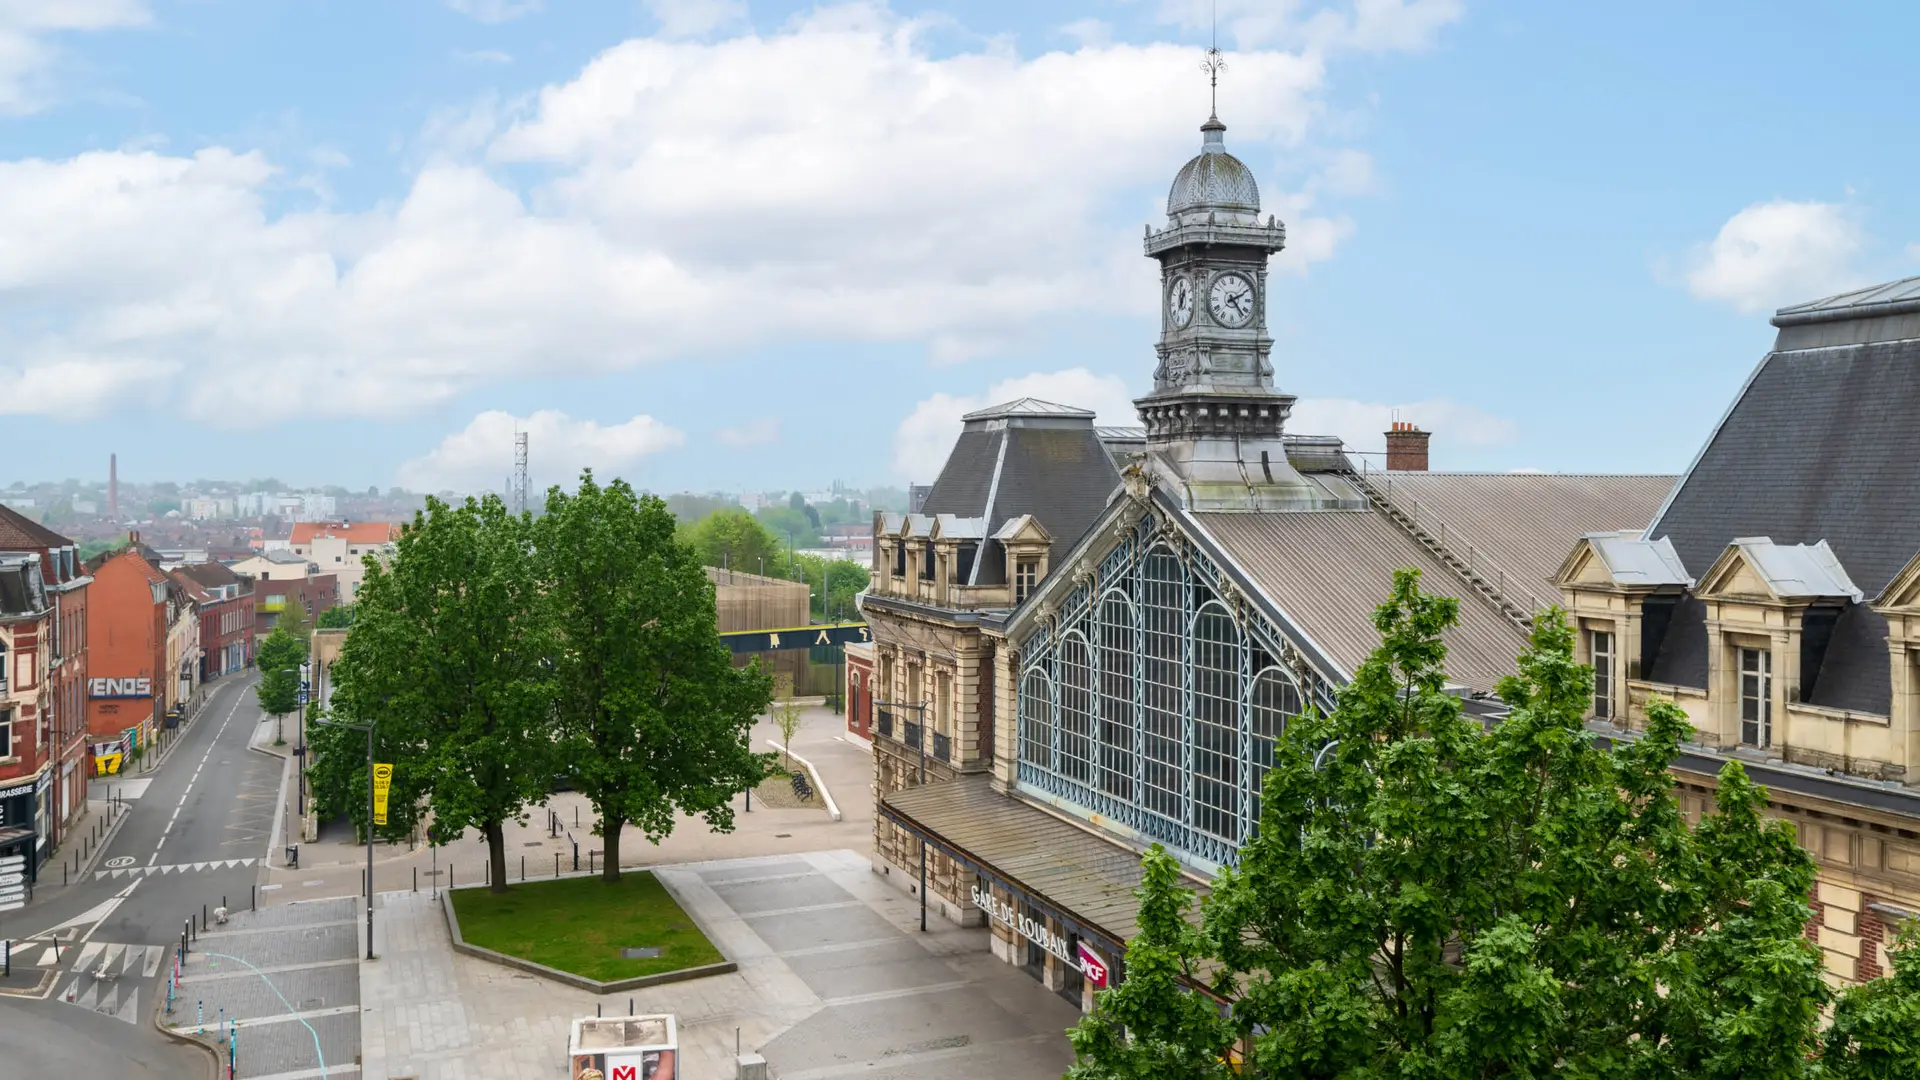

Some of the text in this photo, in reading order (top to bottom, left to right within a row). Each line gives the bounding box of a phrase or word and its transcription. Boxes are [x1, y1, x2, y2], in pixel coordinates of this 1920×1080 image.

[971, 885, 1070, 960] GARE DE ROUBAIX
[1080, 957, 1104, 981] SNCF
